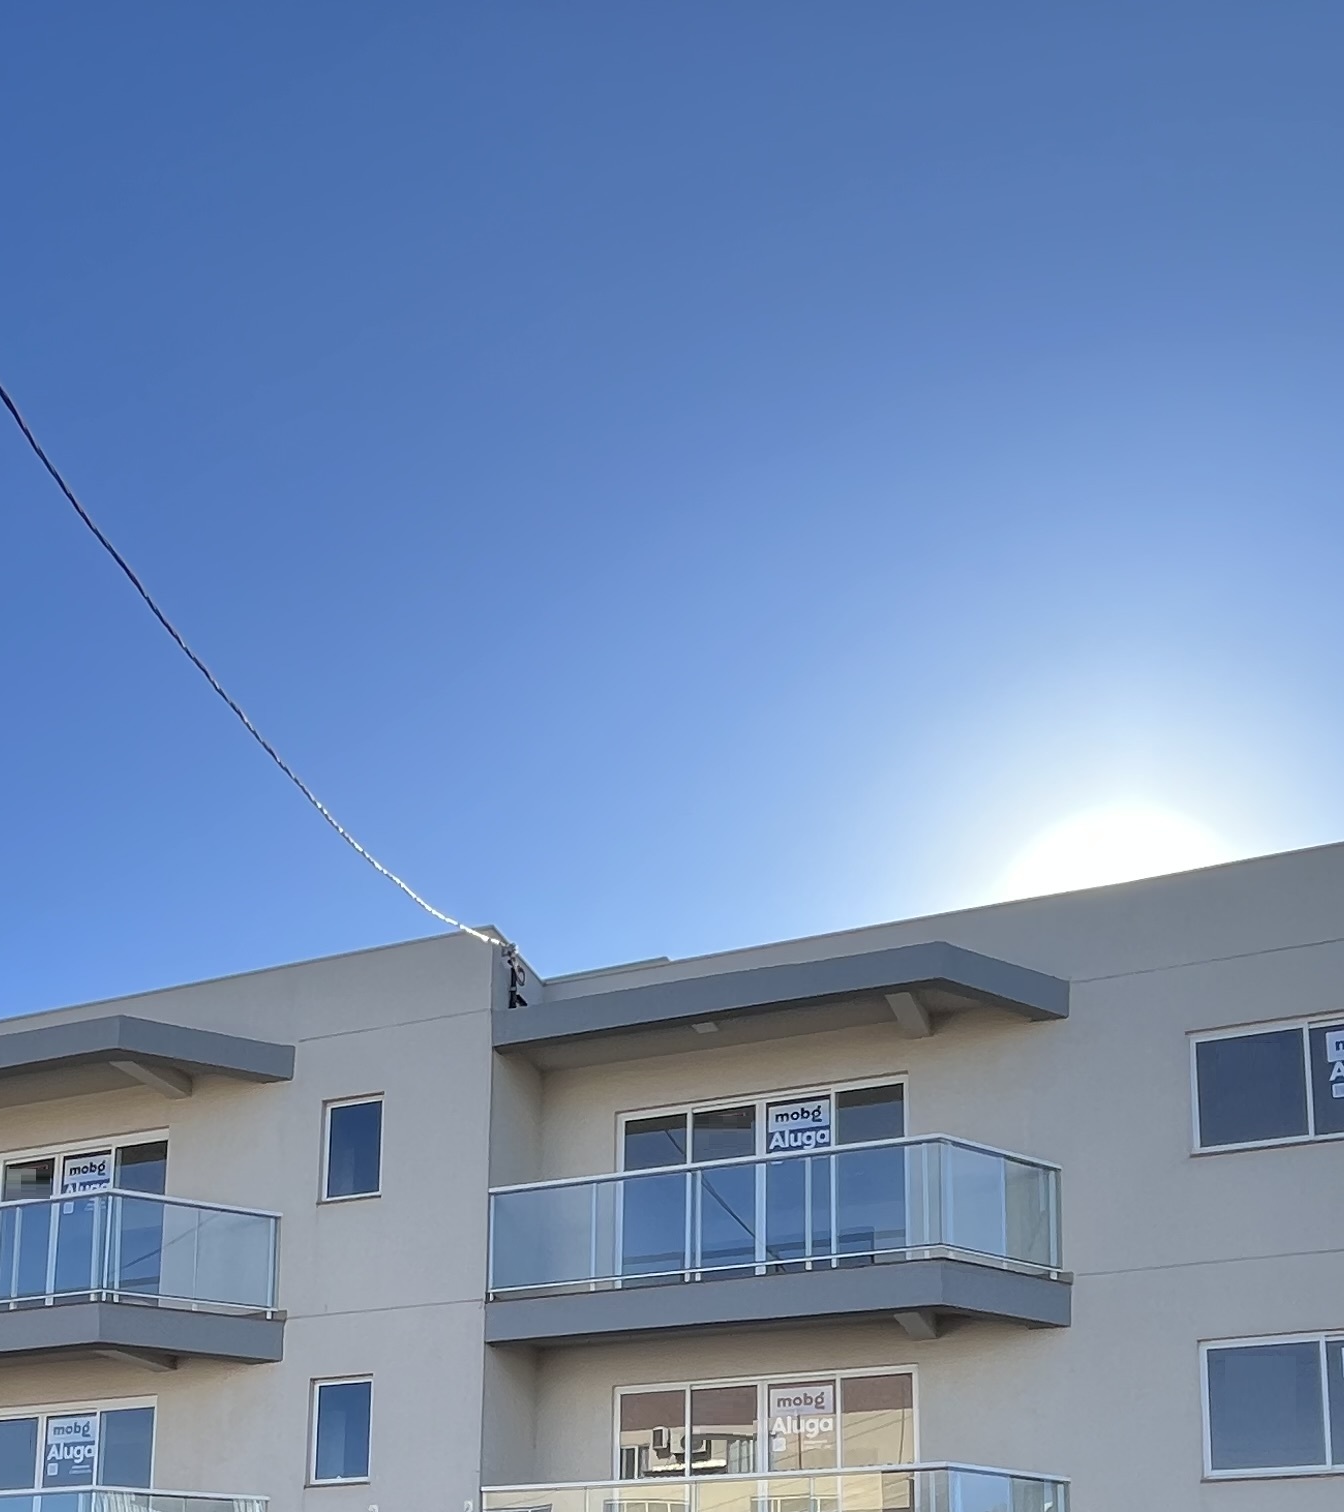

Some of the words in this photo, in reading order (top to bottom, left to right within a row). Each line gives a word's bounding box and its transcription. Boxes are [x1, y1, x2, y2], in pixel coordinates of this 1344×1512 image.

[775, 1105, 822, 1122] mobg
[769, 1129, 830, 1150] Aluga
[69, 1160, 106, 1176] mobg
[777, 1391, 825, 1410] mobg
[53, 1420, 91, 1437] mobg
[770, 1416, 833, 1439] Aluga
[47, 1442, 96, 1463] Aluga
